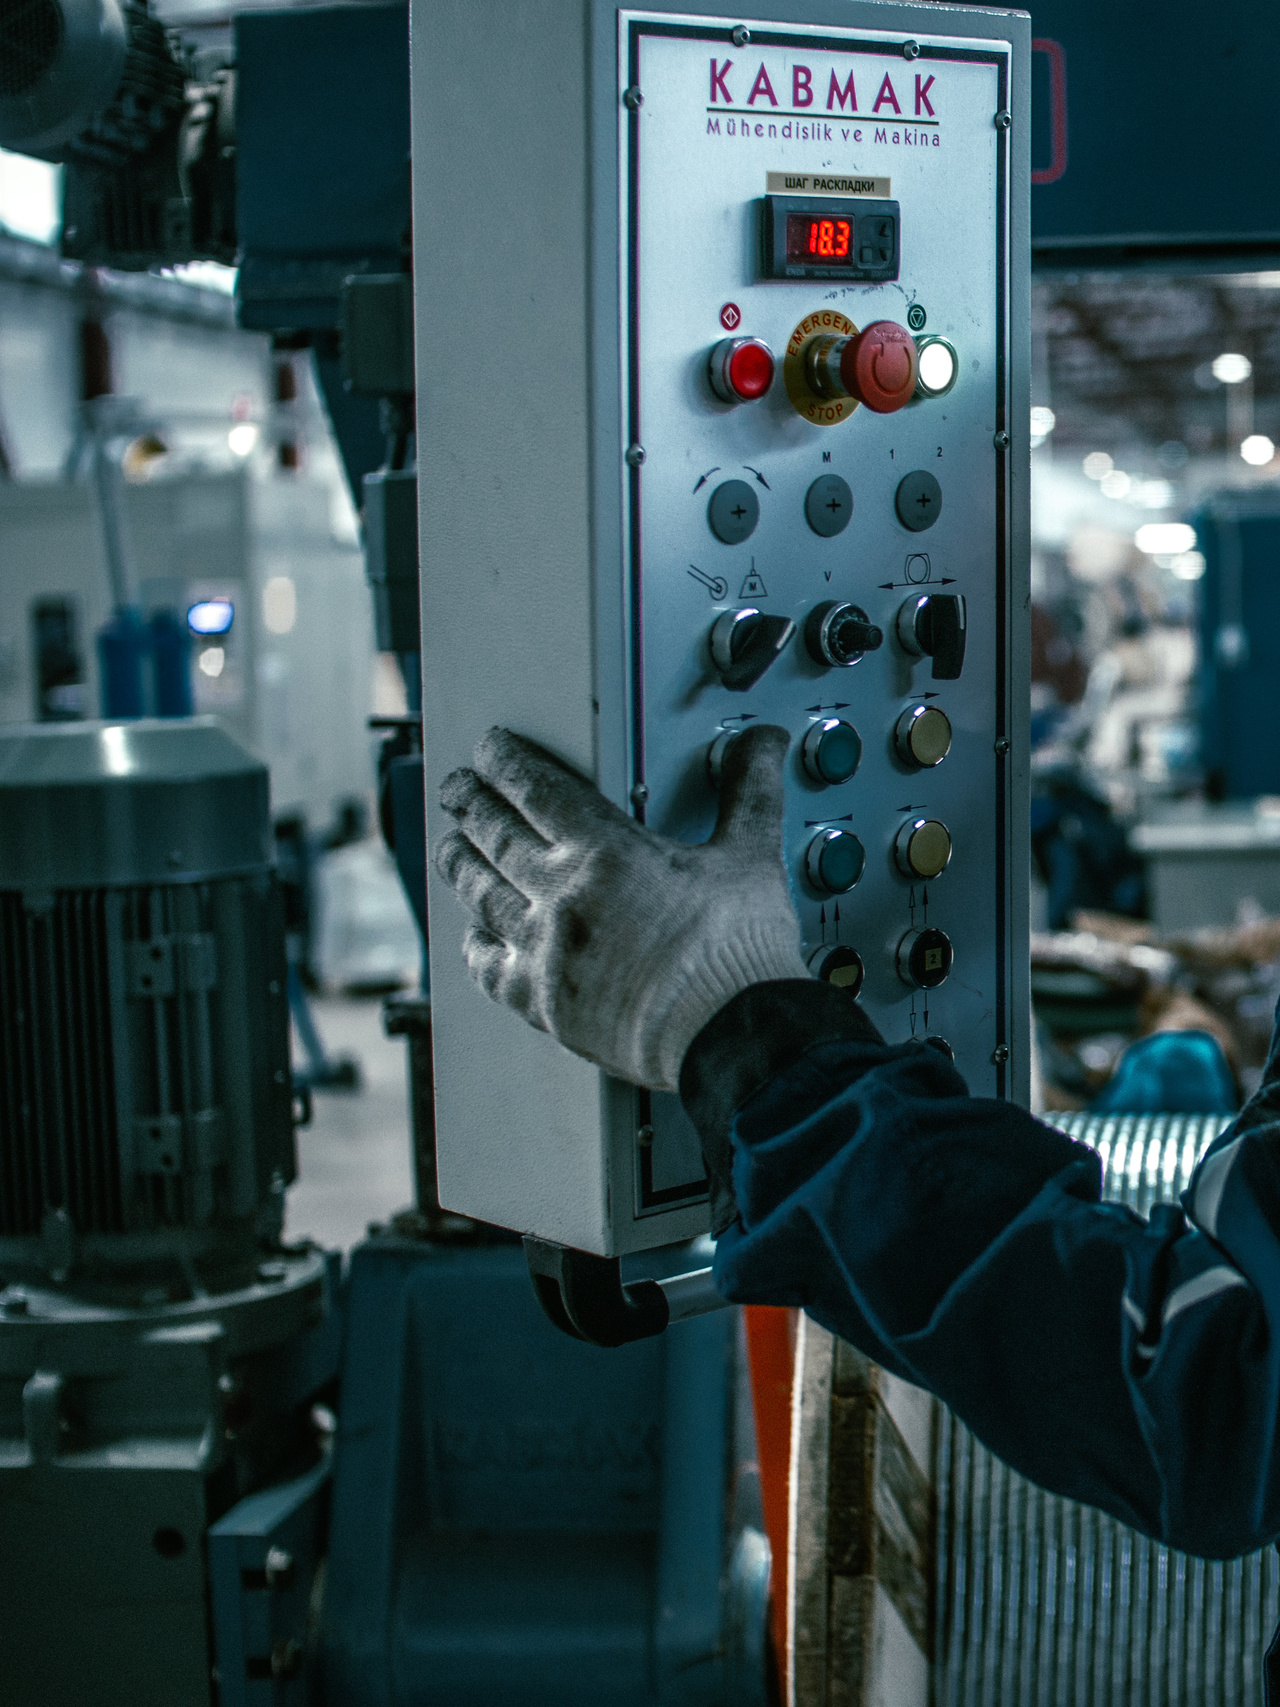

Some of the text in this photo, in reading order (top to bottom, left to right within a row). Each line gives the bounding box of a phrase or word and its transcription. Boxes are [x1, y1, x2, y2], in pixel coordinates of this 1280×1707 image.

[709, 58, 936, 117] KABMAK
[706, 117, 941, 147] Mühendislik ve Makina
[785, 176, 875, 194] ШАГ РАСКЛАДКИ
[787, 312, 859, 357] EMERGEN
[807, 403, 843, 420] STOP
[822, 451, 832, 463] M
[889, 448, 895, 460] 1
[936, 446, 943, 458] 2
[823, 570, 832, 582] V
[930, 953, 937, 964] 2
